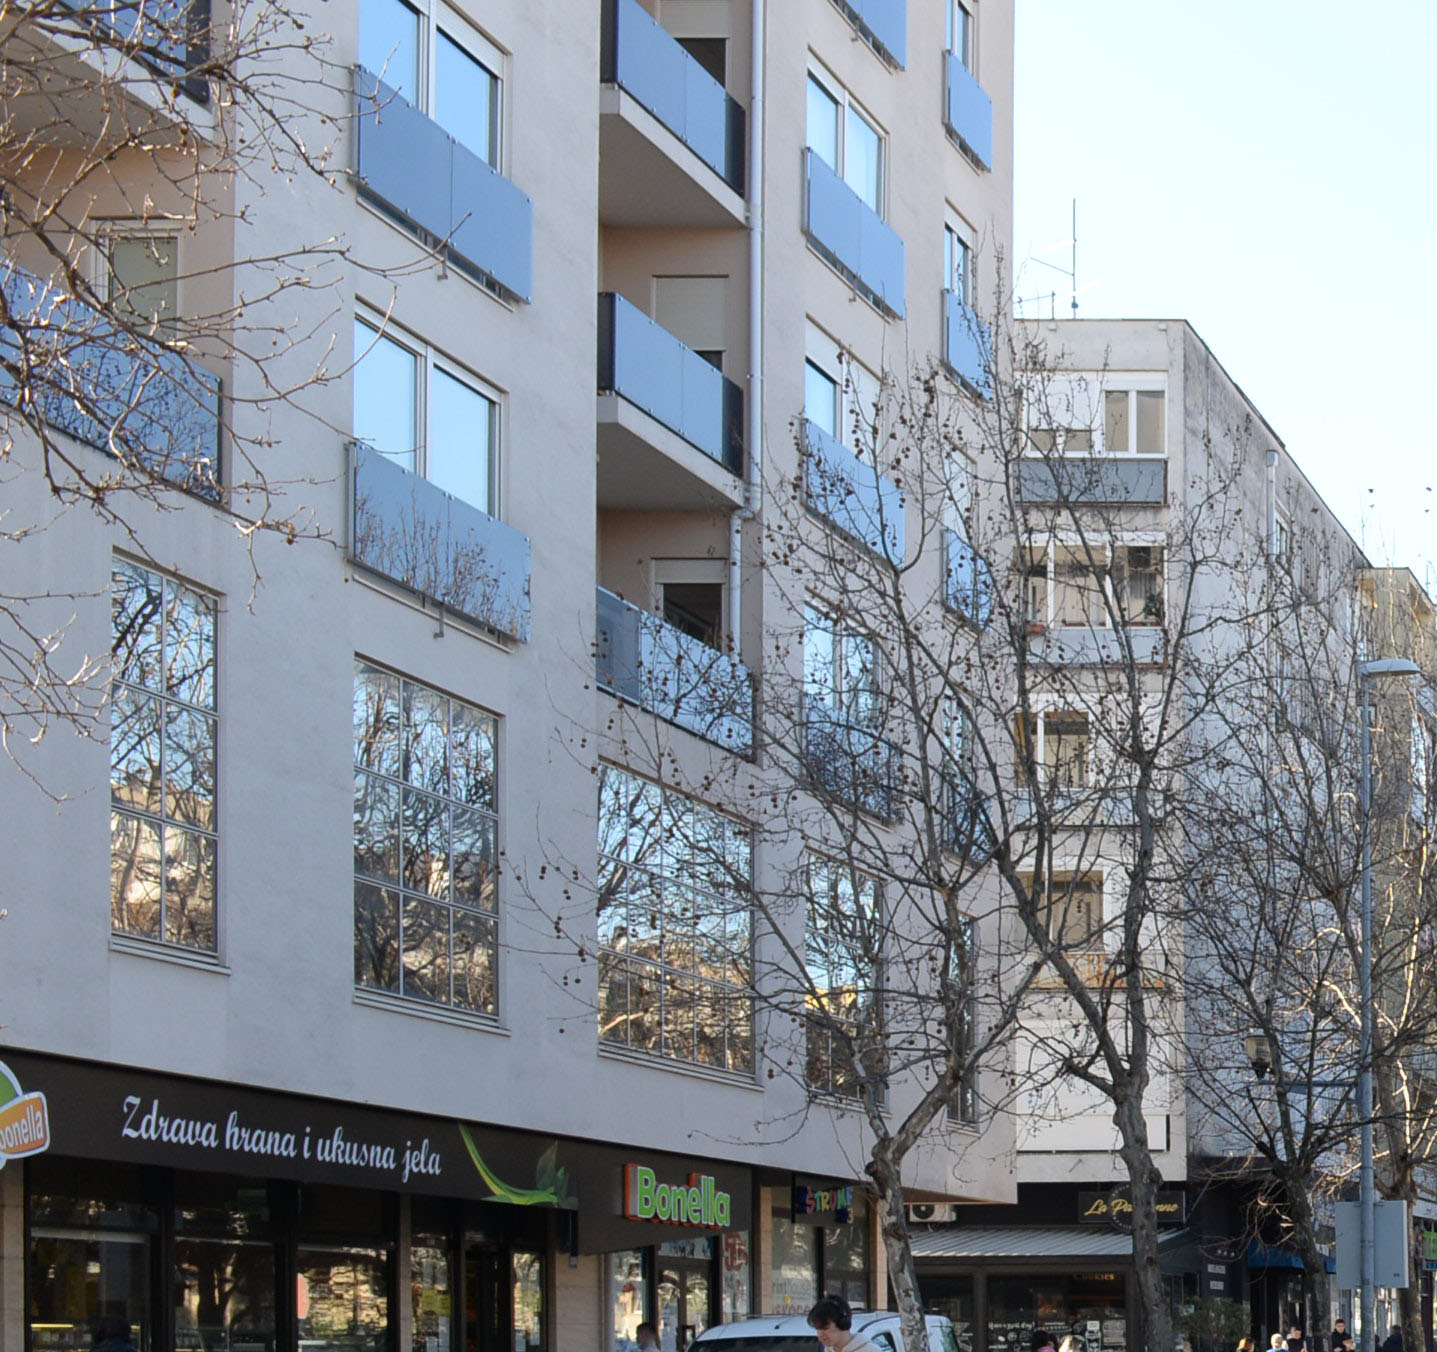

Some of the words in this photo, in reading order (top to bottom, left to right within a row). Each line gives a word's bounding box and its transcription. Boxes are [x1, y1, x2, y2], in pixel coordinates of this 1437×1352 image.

[122, 1095, 219, 1148] Zdrava
[225, 1110, 297, 1158] hrana
[303, 1126, 311, 1160] i
[317, 1126, 397, 1170] ukusna
[401, 1138, 442, 1184] jela
[635, 1165, 731, 1227] Bonella
